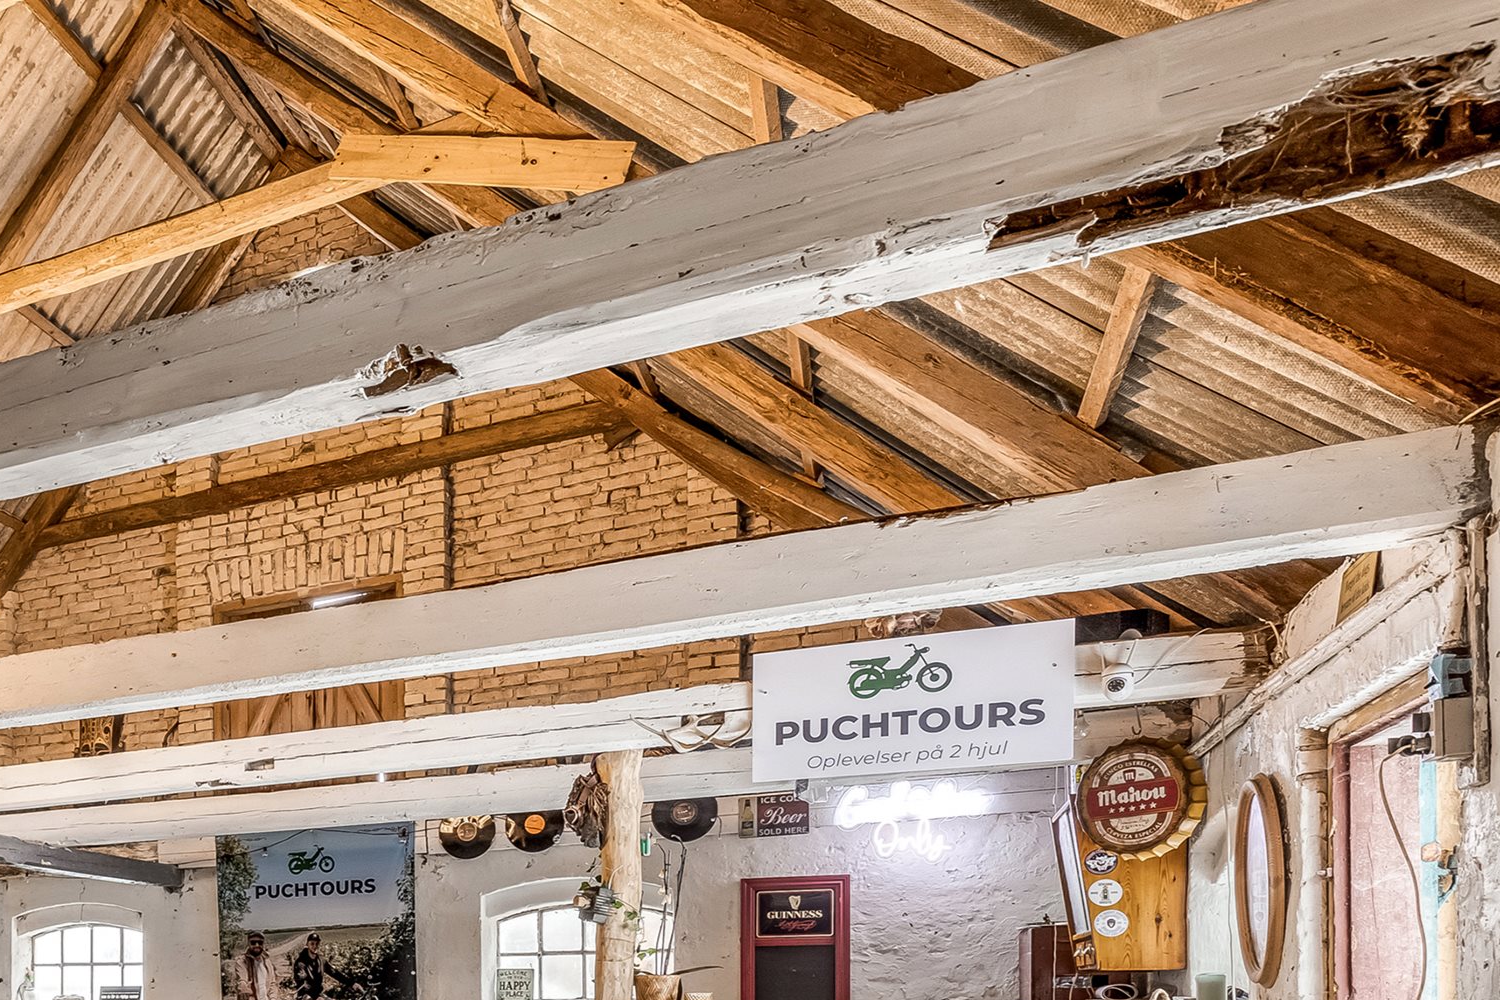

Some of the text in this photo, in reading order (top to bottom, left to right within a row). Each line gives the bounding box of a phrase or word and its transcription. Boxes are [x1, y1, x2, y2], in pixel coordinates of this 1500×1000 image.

[775, 699, 1046, 746] PUCHTOURS
[806, 740, 1008, 771] Oplevelser på 2 hjul
[1103, 763, 1124, 780] CINCO
[760, 795, 801, 804] ICE COL
[1097, 786, 1167, 807] Mahou
[760, 806, 807, 826] Beer
[758, 826, 809, 836] SOLD HERE
[1134, 821, 1163, 838] ESPECIAL
[255, 878, 376, 899] PUCHTOURS
[767, 909, 823, 920] GUINNESS
[500, 981, 531, 990] HAPPY
